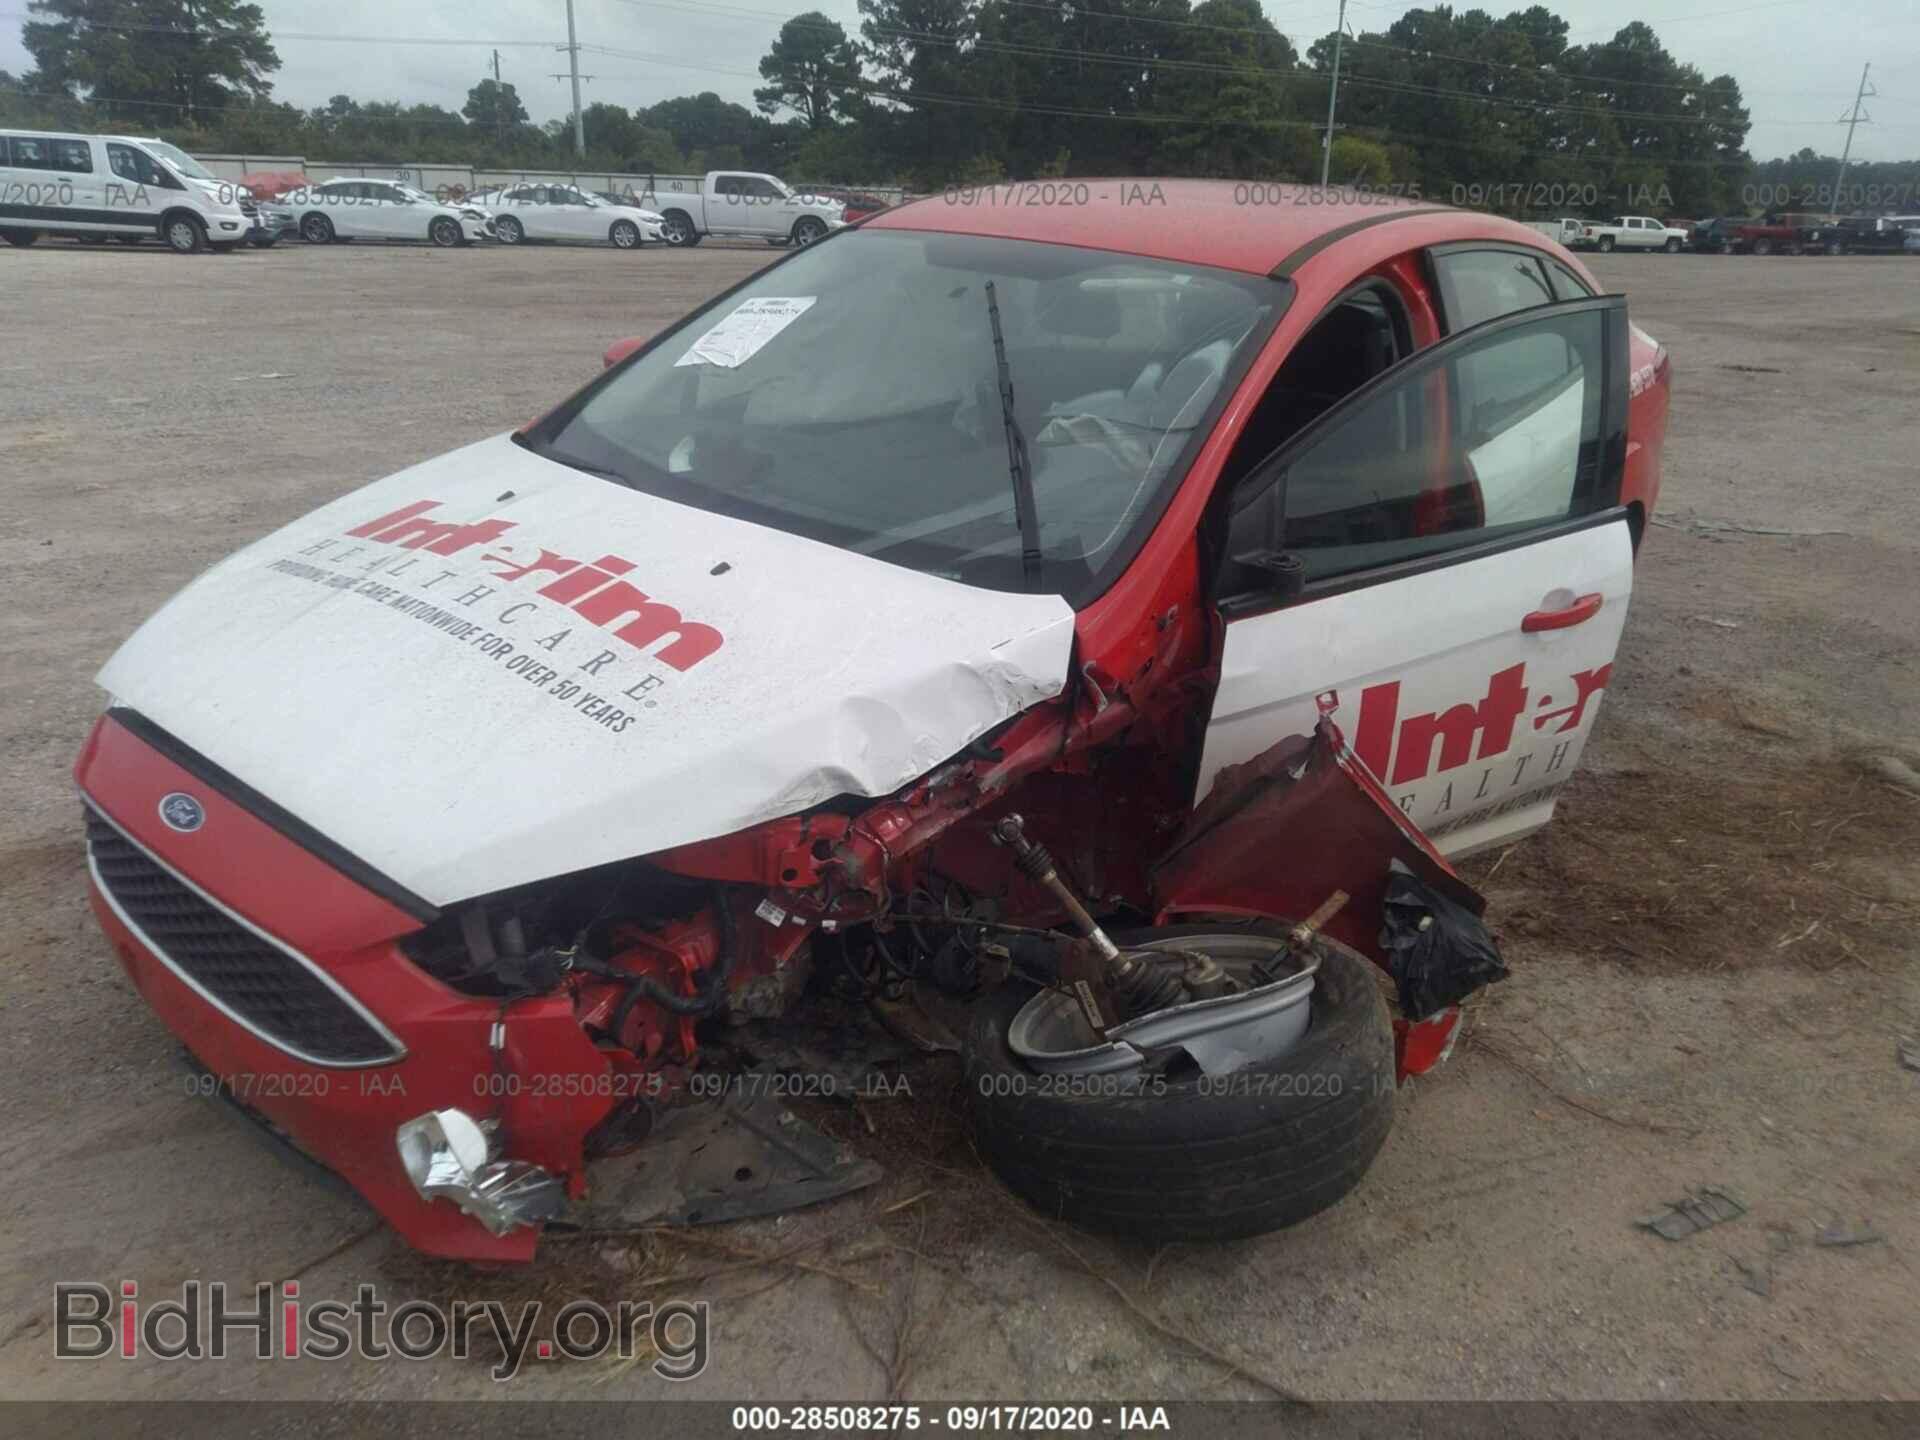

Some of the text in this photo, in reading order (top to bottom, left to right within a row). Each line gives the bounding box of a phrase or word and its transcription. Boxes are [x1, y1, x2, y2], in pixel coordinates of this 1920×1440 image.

[344, 500, 724, 673] Interim
[387, 594, 483, 642] NATIONWIDE
[470, 632, 515, 660] FOR
[506, 654, 558, 688] OVER
[550, 679, 582, 701] 50
[573, 691, 637, 734] YEARS
